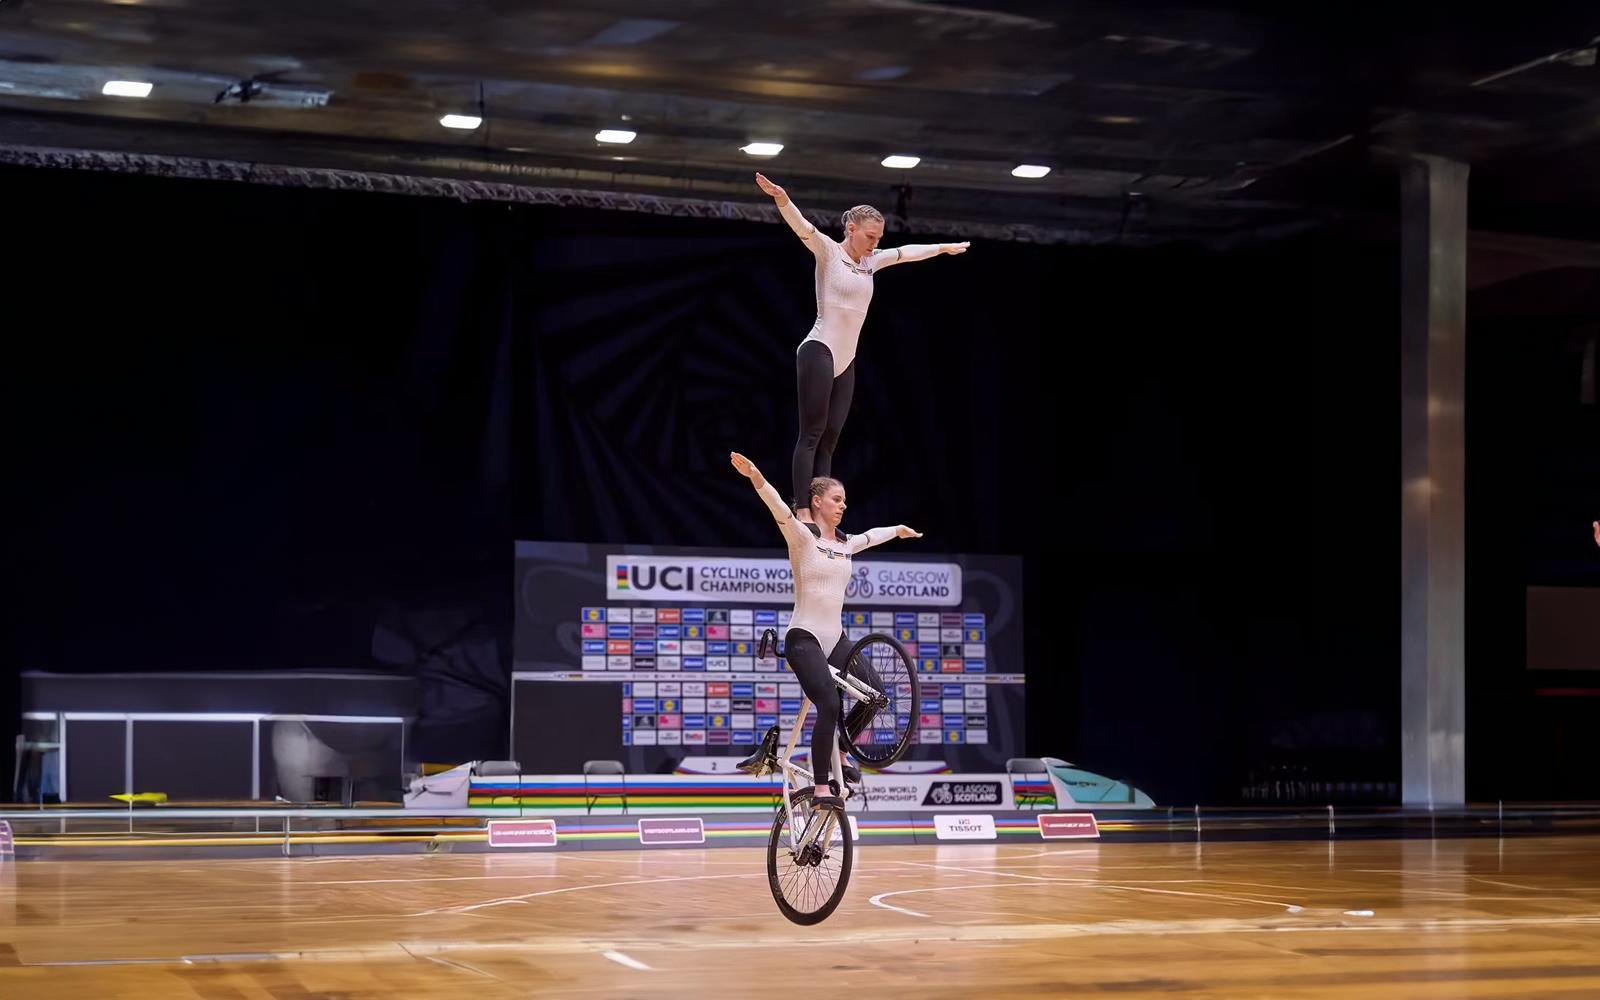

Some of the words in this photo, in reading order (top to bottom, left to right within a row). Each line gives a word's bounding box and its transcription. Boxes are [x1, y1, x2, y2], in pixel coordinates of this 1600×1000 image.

[631, 565, 694, 592] UCI
[700, 566, 760, 580] CYCLING
[878, 569, 950, 585] GLASGOW
[700, 580, 795, 594] CHAMPIONSH
[878, 584, 950, 598] SCOTLAND
[888, 786, 918, 794] WORLD
[953, 784, 997, 794] GLASGOW
[953, 793, 998, 802] SCOTLAND
[949, 824, 982, 832] TISSOT
